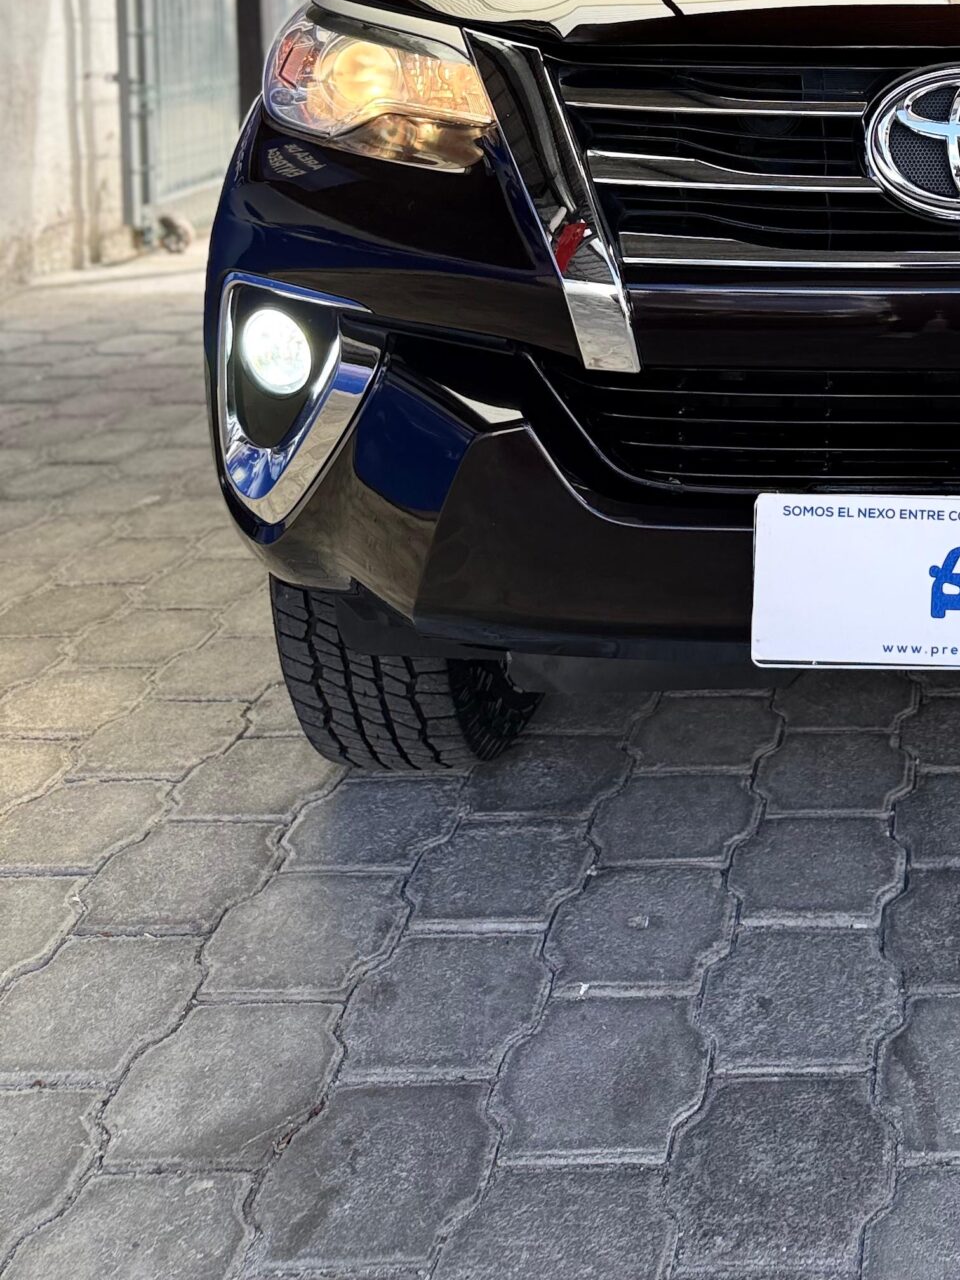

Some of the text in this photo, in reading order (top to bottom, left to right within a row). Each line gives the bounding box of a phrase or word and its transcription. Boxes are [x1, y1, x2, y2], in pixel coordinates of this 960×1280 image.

[783, 505, 834, 518] SOMOS
[838, 506, 854, 518] EL
[857, 507, 896, 519] NEXO
[899, 508, 945, 520] ENTRE
